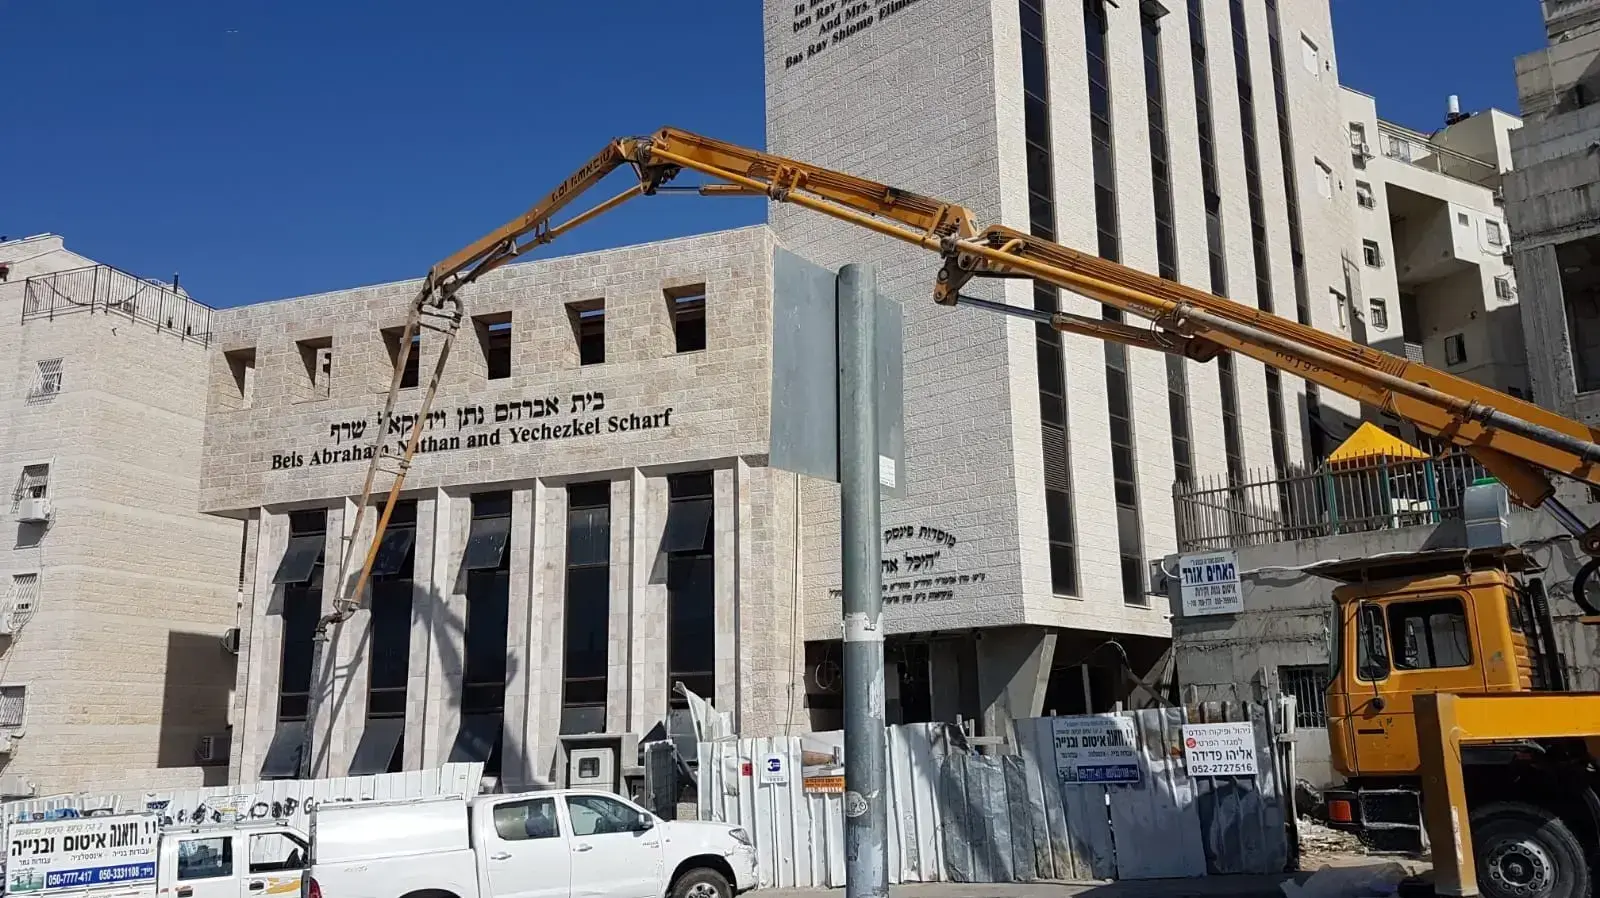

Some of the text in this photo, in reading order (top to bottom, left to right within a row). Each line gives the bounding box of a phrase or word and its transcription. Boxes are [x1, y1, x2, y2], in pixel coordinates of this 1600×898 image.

[793, 15, 811, 33] ben
[819, 13, 841, 36] And
[832, 15, 873, 45] Shlomo
[495, 396, 559, 422] אברהם
[570, 391, 605, 413] בית
[457, 405, 484, 432] נתן
[272, 451, 303, 470] Beis
[467, 429, 500, 448] and
[509, 417, 600, 444] Yechezkel
[608, 408, 673, 433] Scharf
[330, 420, 367, 445] שרף
[884, 525, 956, 548] מוסדות פינסק
[1206, 563, 1236, 582] האחים
[1056, 736, 1079, 748] ובנייה
[1082, 736, 1107, 748] איטום
[1226, 746, 1253, 760] אליהו
[1192, 763, 1252, 773] 052-2727516
[12, 837, 54, 856] ובנייה
[63, 832, 107, 852] איטום
